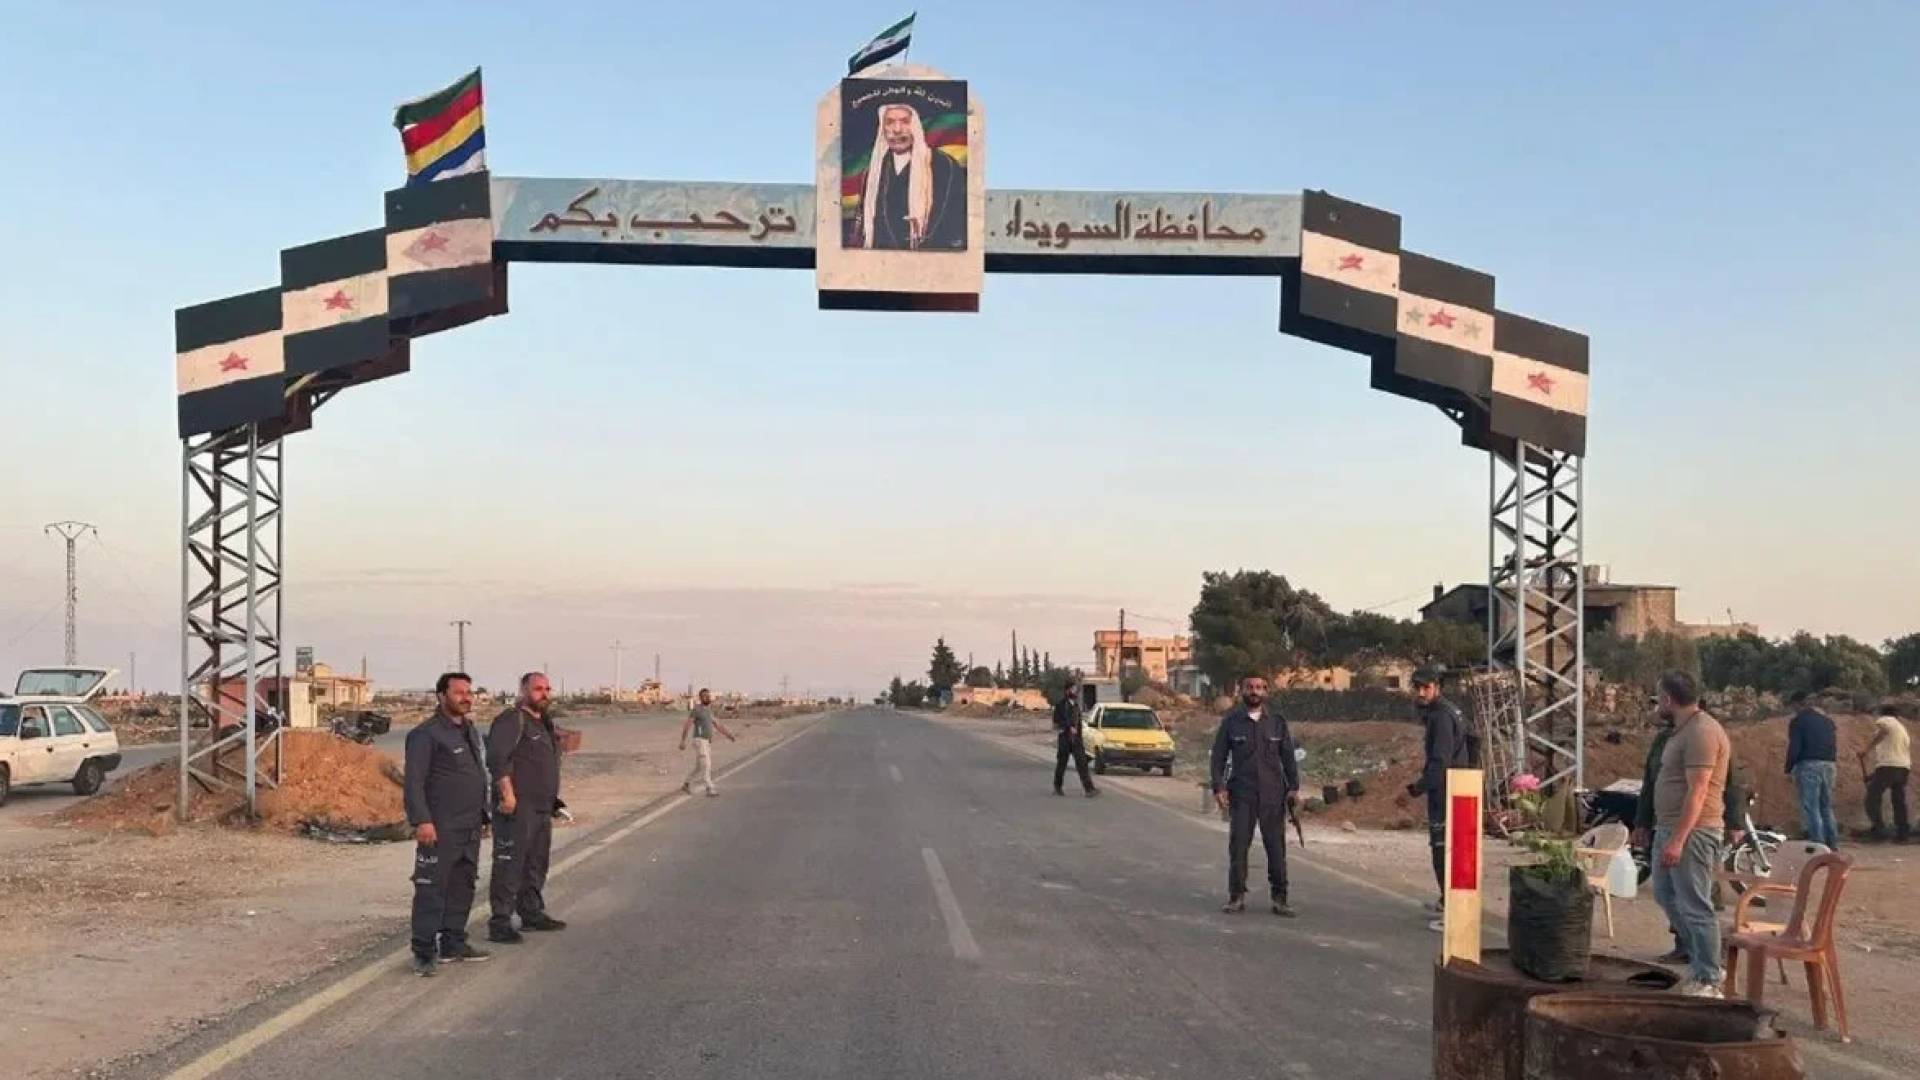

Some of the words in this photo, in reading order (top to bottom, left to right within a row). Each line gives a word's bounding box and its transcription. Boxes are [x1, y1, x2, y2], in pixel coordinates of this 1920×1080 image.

[529, 186, 619, 239] بكم
[630, 207, 797, 240] ترحب
[1004, 198, 1132, 248] السويداء
[1133, 199, 1267, 244] محافظة
